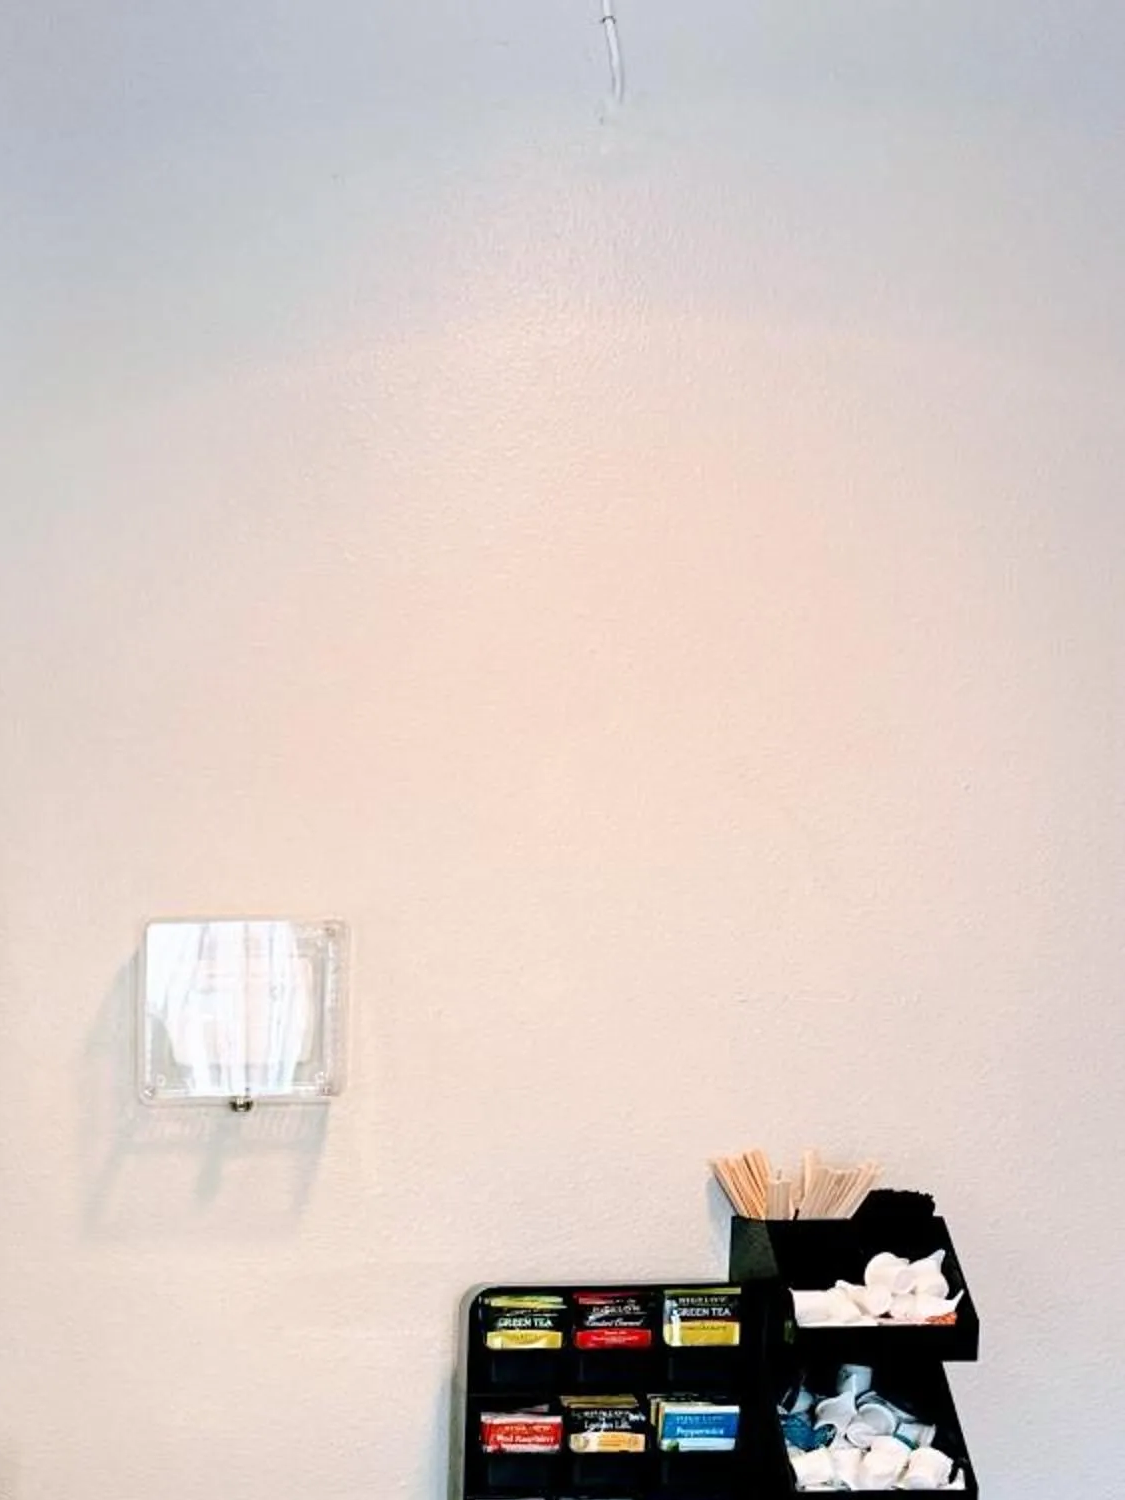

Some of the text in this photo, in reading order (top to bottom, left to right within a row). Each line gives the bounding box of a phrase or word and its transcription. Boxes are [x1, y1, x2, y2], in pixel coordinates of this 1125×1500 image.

[678, 1307, 731, 1317] GREEN TEA
[497, 1317, 553, 1328] GREEN TEA
